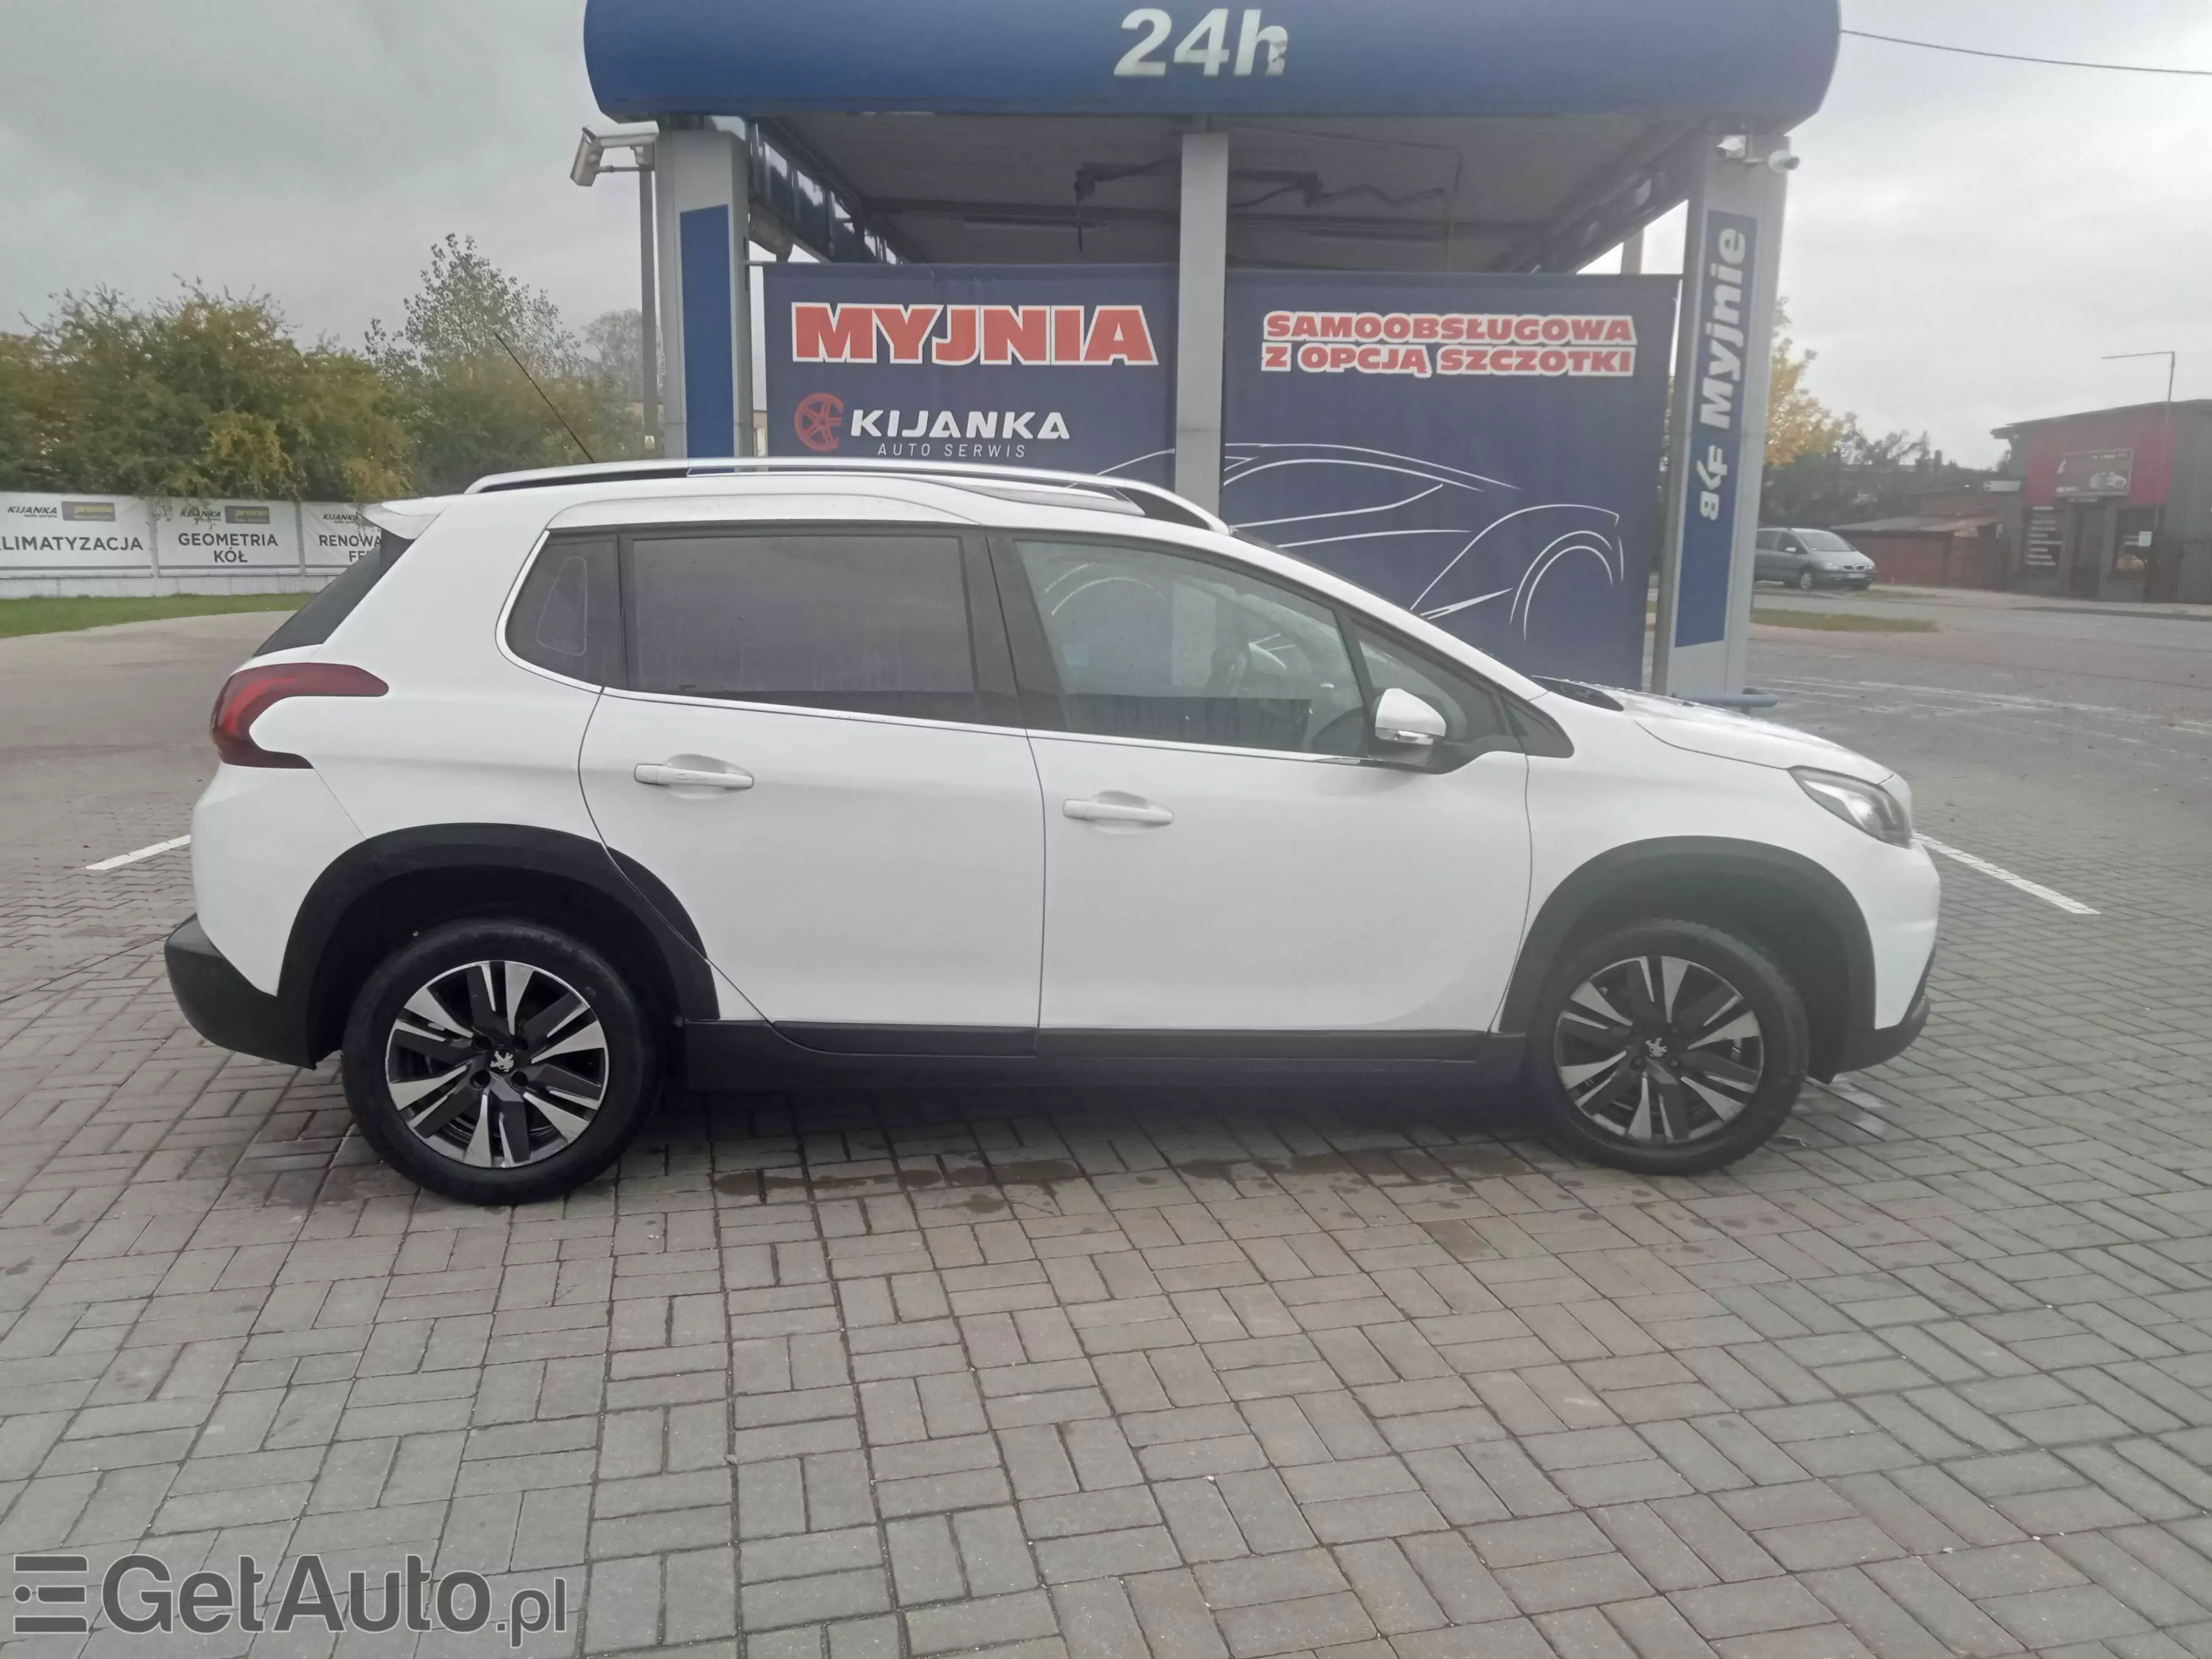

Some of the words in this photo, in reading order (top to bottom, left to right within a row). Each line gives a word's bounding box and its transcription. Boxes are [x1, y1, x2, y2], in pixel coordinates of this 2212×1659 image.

[1113, 8, 1288, 75] 24h
[791, 302, 1158, 365] MYJNIA
[1264, 311, 1637, 345] SAMOOBSŁUGOWA
[1699, 228, 1746, 430] Myjnie
[1262, 342, 1291, 372] Z
[1298, 344, 1431, 377] OPCJĄ
[1437, 347, 1636, 376] SZCZOTKI
[851, 410, 1070, 439] KIJANKA
[877, 443, 930, 457] AUTO
[944, 444, 1025, 457] SERWIS
[7, 506, 57, 514] KIJANKA
[0, 536, 143, 551] LIMATYZACJA
[178, 533, 278, 546] GEOMETRIA
[214, 547, 248, 563] KÓŁ
